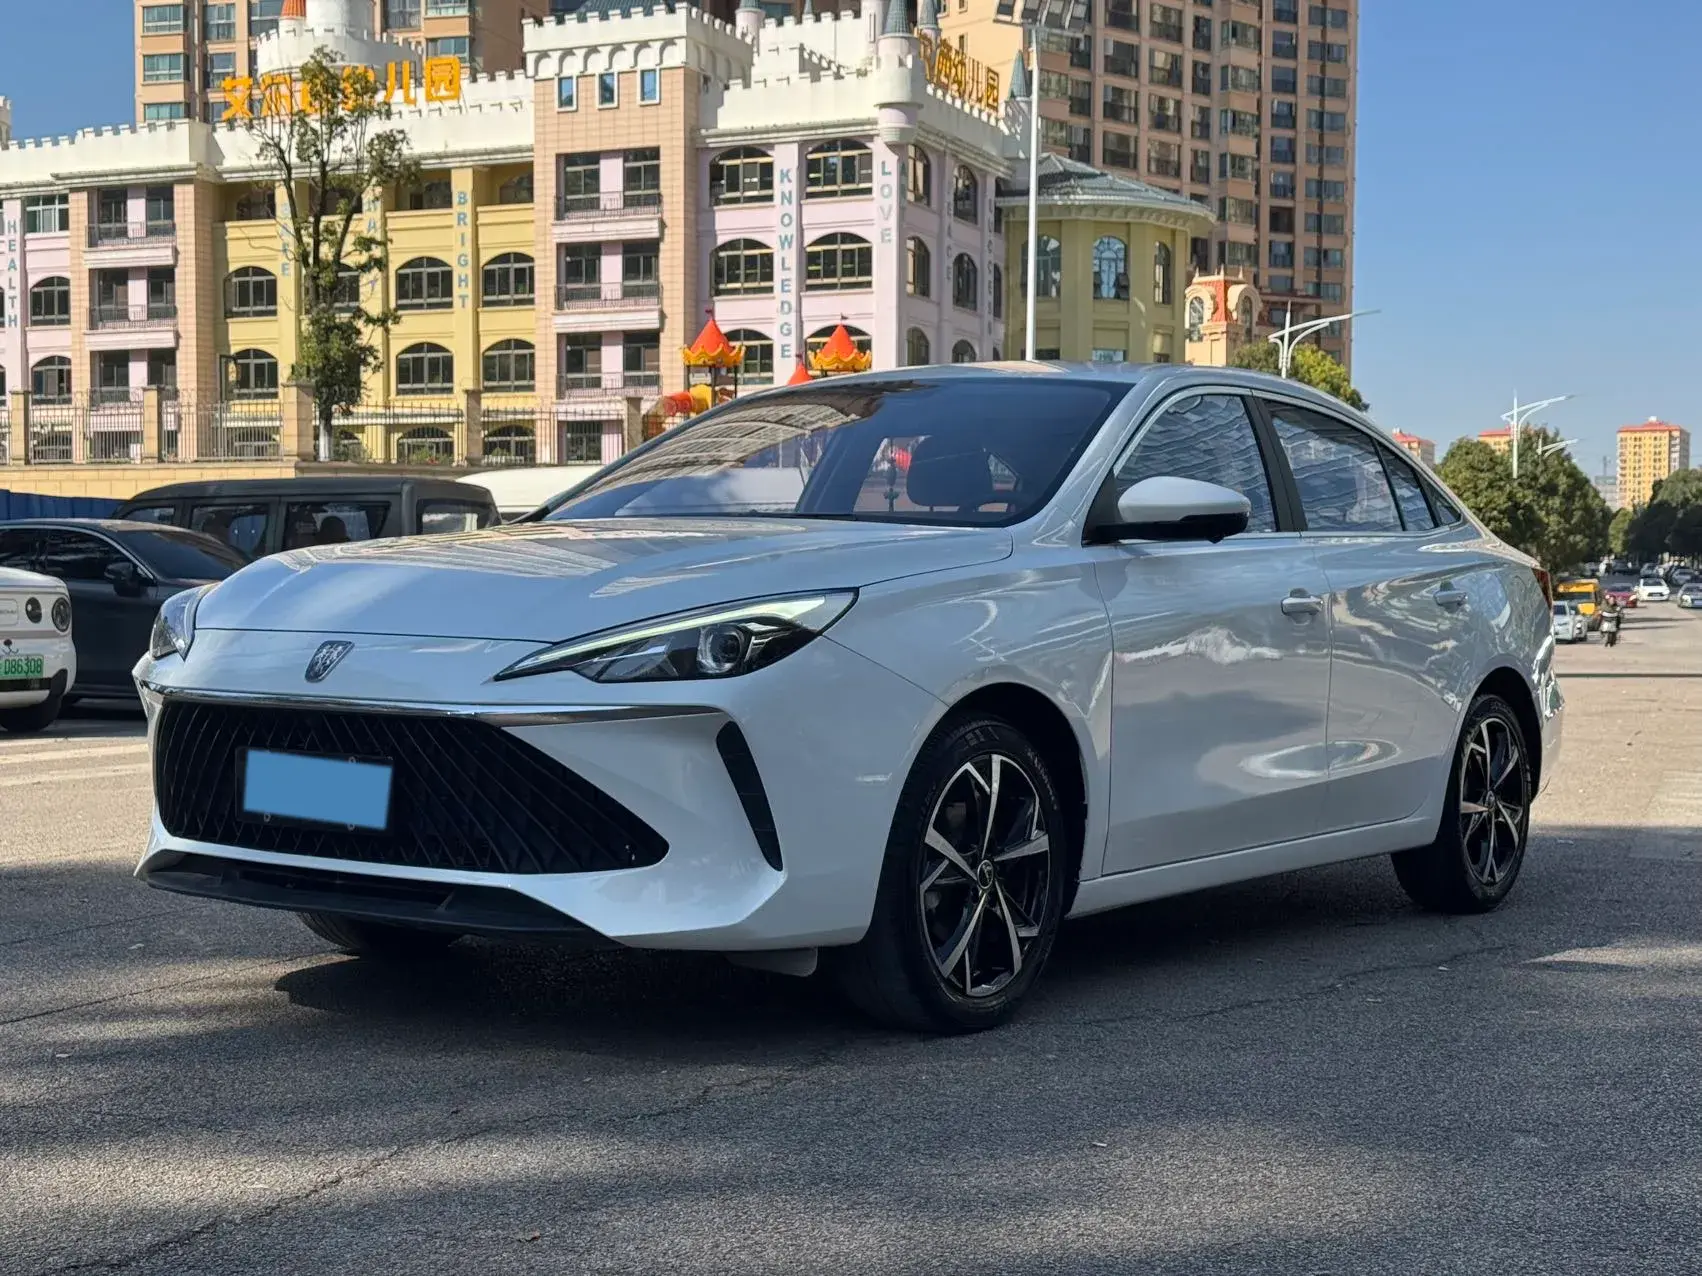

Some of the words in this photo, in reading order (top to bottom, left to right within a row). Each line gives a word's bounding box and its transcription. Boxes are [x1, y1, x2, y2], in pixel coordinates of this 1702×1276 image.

[457, 191, 469, 308] BRIGHT
[880, 161, 892, 243] LOVE
[8, 220, 17, 328] HEALTH
[779, 167, 793, 358] KNOWLEDGE
